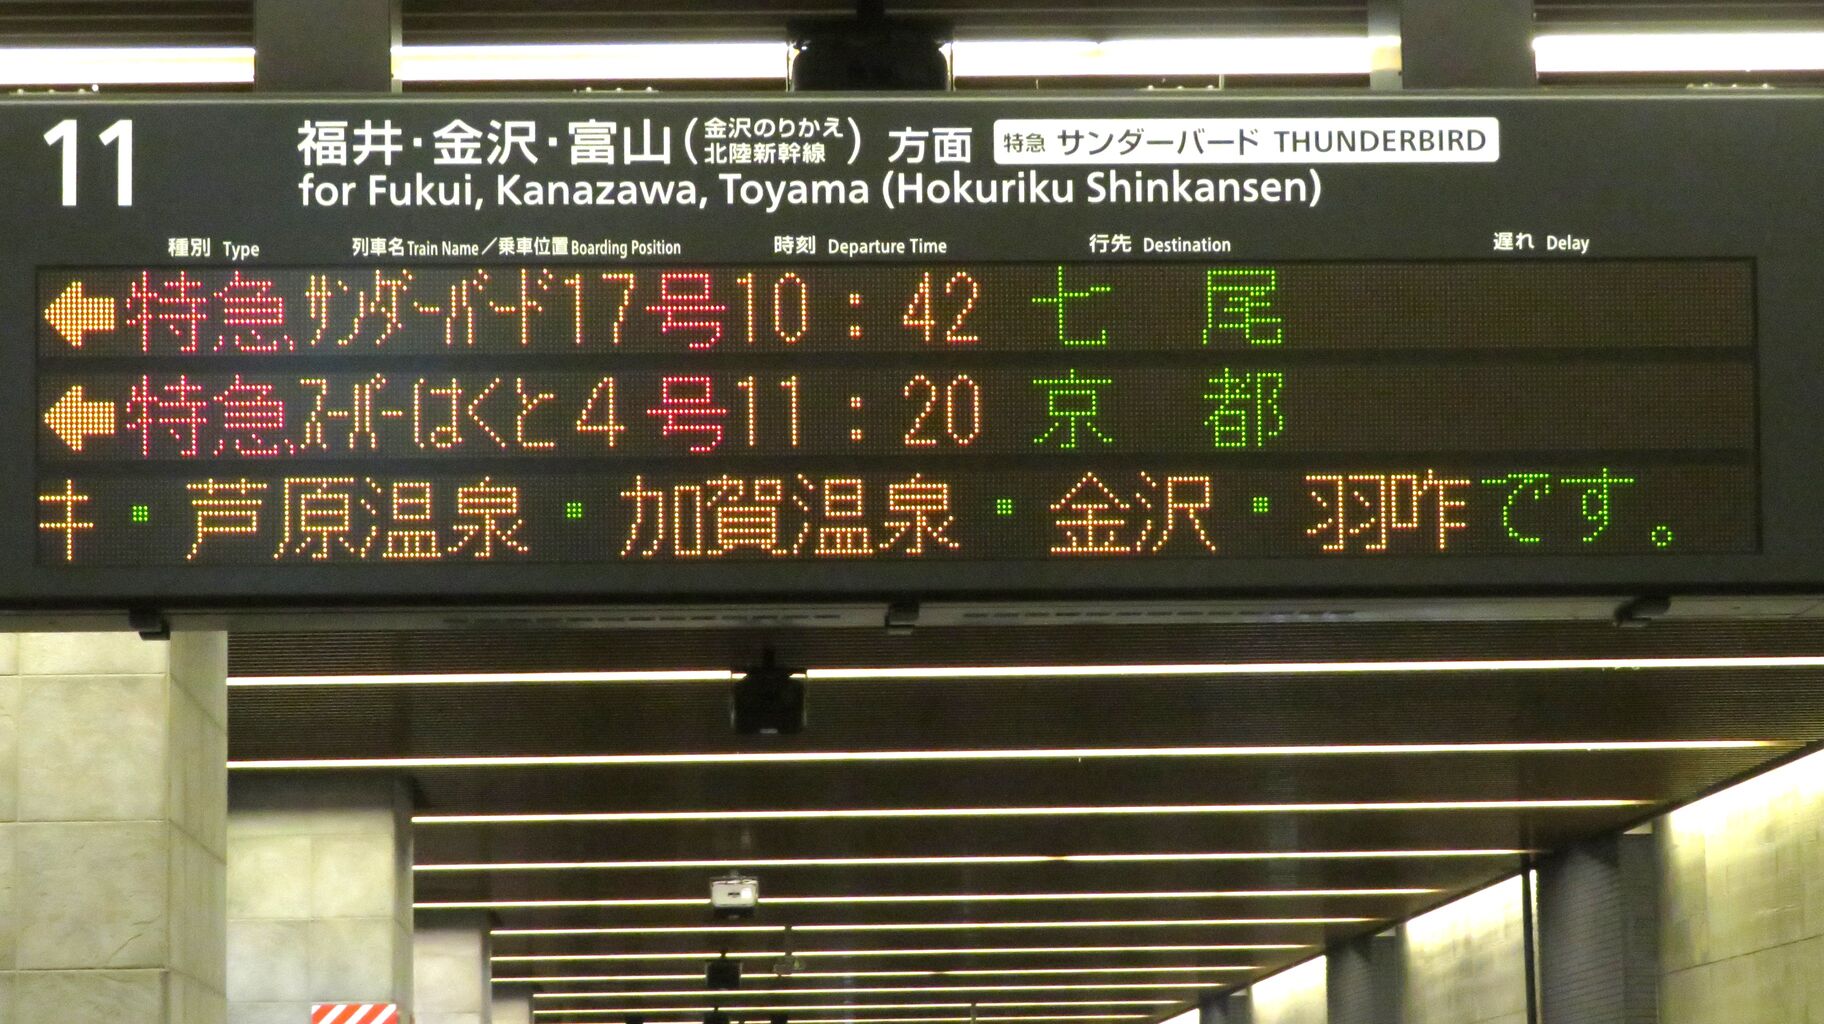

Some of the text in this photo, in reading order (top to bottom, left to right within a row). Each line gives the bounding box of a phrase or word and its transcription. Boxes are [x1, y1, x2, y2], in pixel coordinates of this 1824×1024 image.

[704, 117, 843, 138] 金沢のりかえ
[297, 119, 670, 166] 福井・金沢・富山
[888, 127, 972, 163] 方面
[704, 142, 825, 164] 北陸新幹線
[1004, 130, 1485, 155] 特急 サンダーバード THUNDERBIRD
[44, 119, 132, 206] 11
[298, 169, 1321, 213] for Fukui, Kanazawa, Toyama (Hokuriku Shinkansen)
[168, 238, 259, 261] 種別 Type
[352, 237, 404, 256] 列車名
[407, 241, 438, 256] Train
[442, 241, 479, 255] Name
[499, 237, 568, 255] 乗車位置
[572, 239, 627, 259] Boarding
[632, 240, 681, 255] Position
[774, 235, 947, 257] 時刻 Departure Time
[1089, 234, 1230, 253] 行先 Destination
[1493, 232, 1589, 254] 遅れ Delay
[126, 271, 294, 352] 特急
[737, 272, 978, 343] 10:42
[1032, 266, 1281, 345] 七尾
[126, 374, 296, 456] 特急
[738, 375, 979, 446] 11:20
[1033, 368, 1283, 448] 京都
